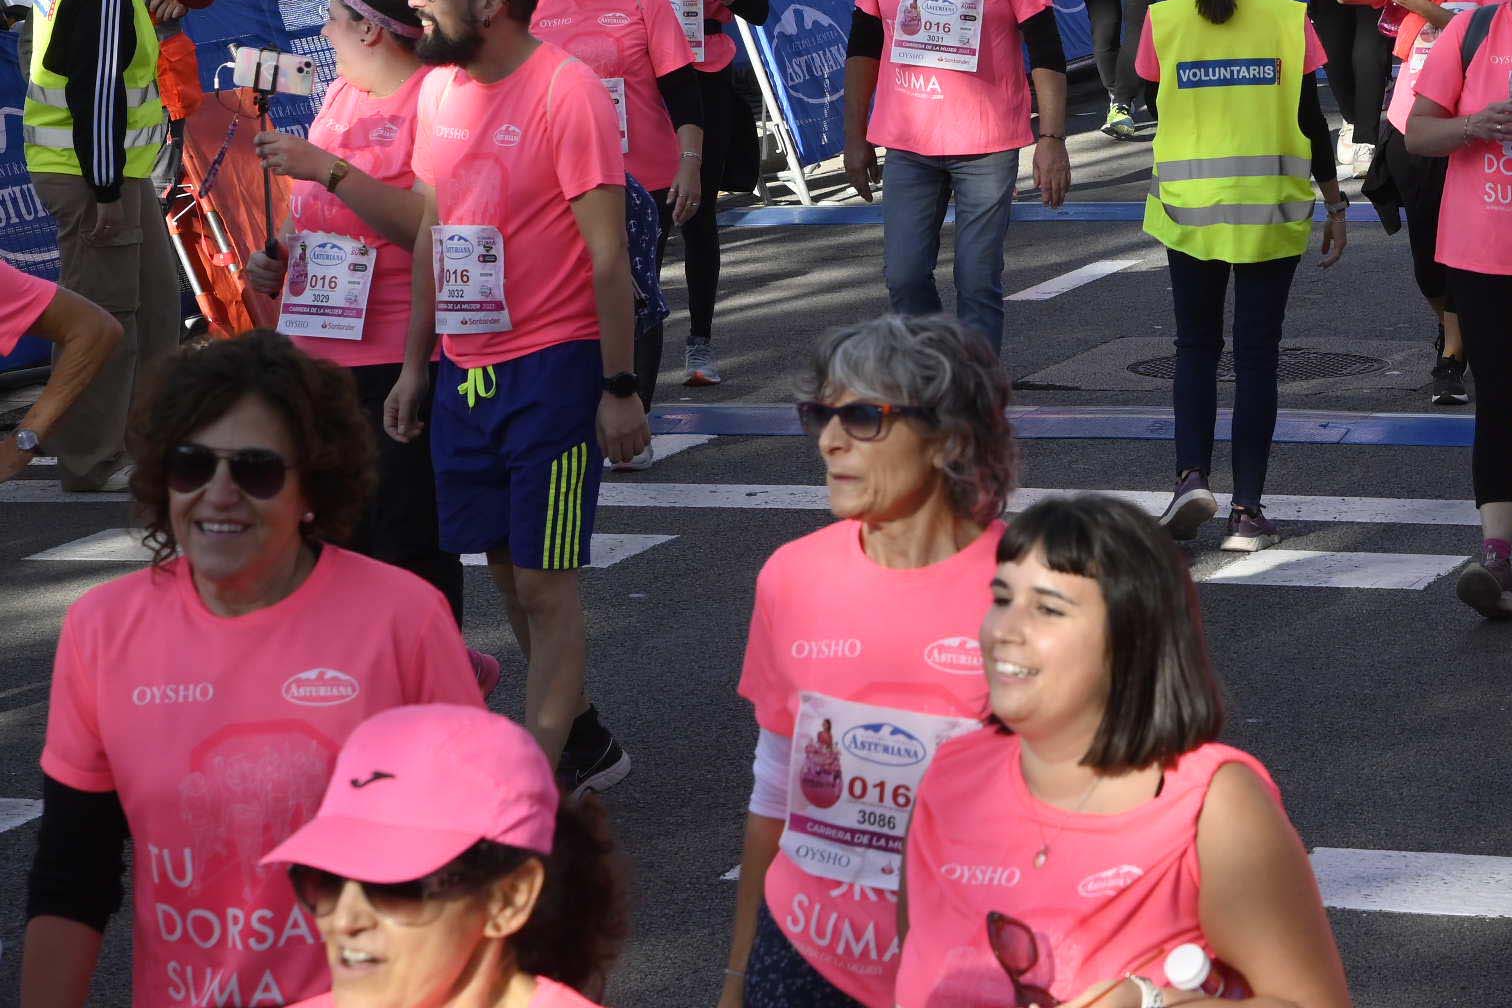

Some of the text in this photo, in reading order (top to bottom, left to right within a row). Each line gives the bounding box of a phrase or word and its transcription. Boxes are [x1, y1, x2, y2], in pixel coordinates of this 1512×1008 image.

[924, 21, 952, 34] 016
[927, 34, 944, 43] 3031
[895, 68, 942, 92] SUMA
[1180, 64, 1273, 83] VOLUNTARIS
[309, 274, 338, 290] 016
[446, 268, 470, 284] 016
[312, 294, 330, 303] 3029
[791, 639, 863, 659] OYSHO
[132, 682, 214, 706] OYSHO
[289, 681, 353, 698] ASTURIANA
[849, 733, 920, 761] ASTURIANA
[847, 776, 912, 808] 016
[857, 810, 897, 830] 3086
[806, 821, 886, 847] CARRERA DE LA
[148, 844, 194, 888] TU
[795, 844, 851, 868] OYSHO
[941, 862, 1021, 888] OYSHO
[157, 903, 327, 952] DORSA
[167, 959, 286, 1008] SUMA
